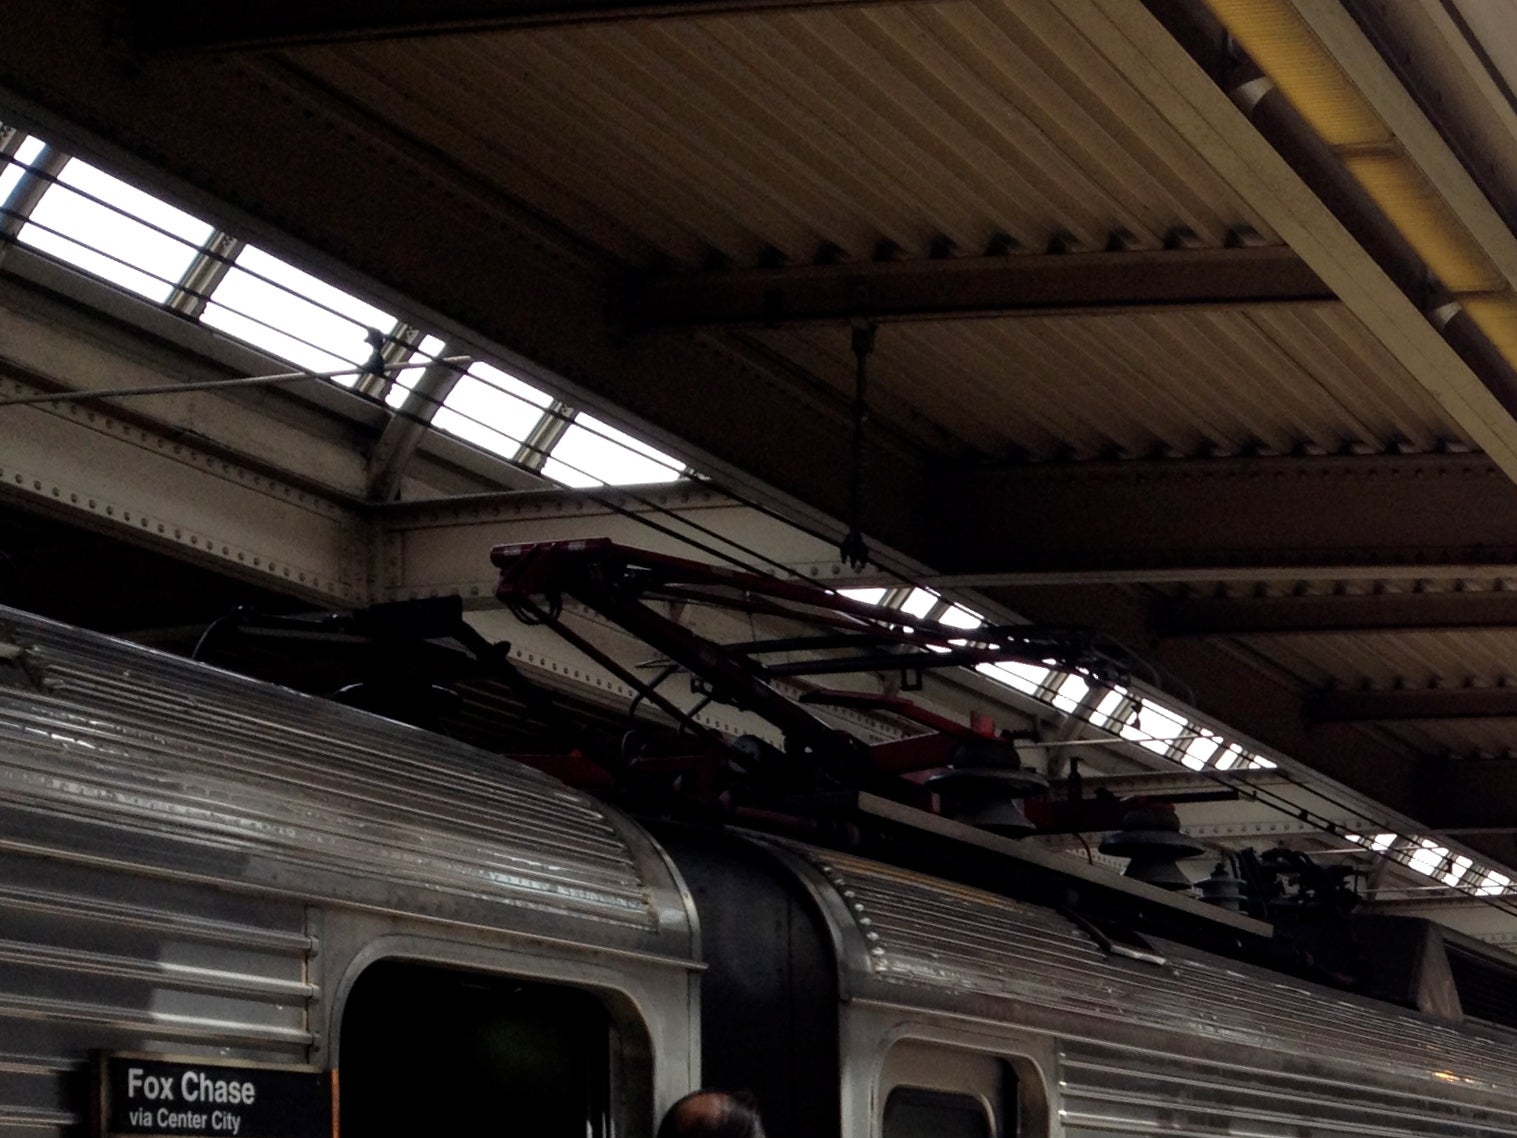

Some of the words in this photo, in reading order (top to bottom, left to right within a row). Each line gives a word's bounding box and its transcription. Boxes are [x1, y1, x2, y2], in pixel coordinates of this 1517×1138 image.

[127, 1068, 175, 1101] Fox
[180, 1071, 256, 1105] Chase
[129, 1109, 153, 1127] via
[156, 1109, 208, 1131] Center
[211, 1111, 241, 1135] City
